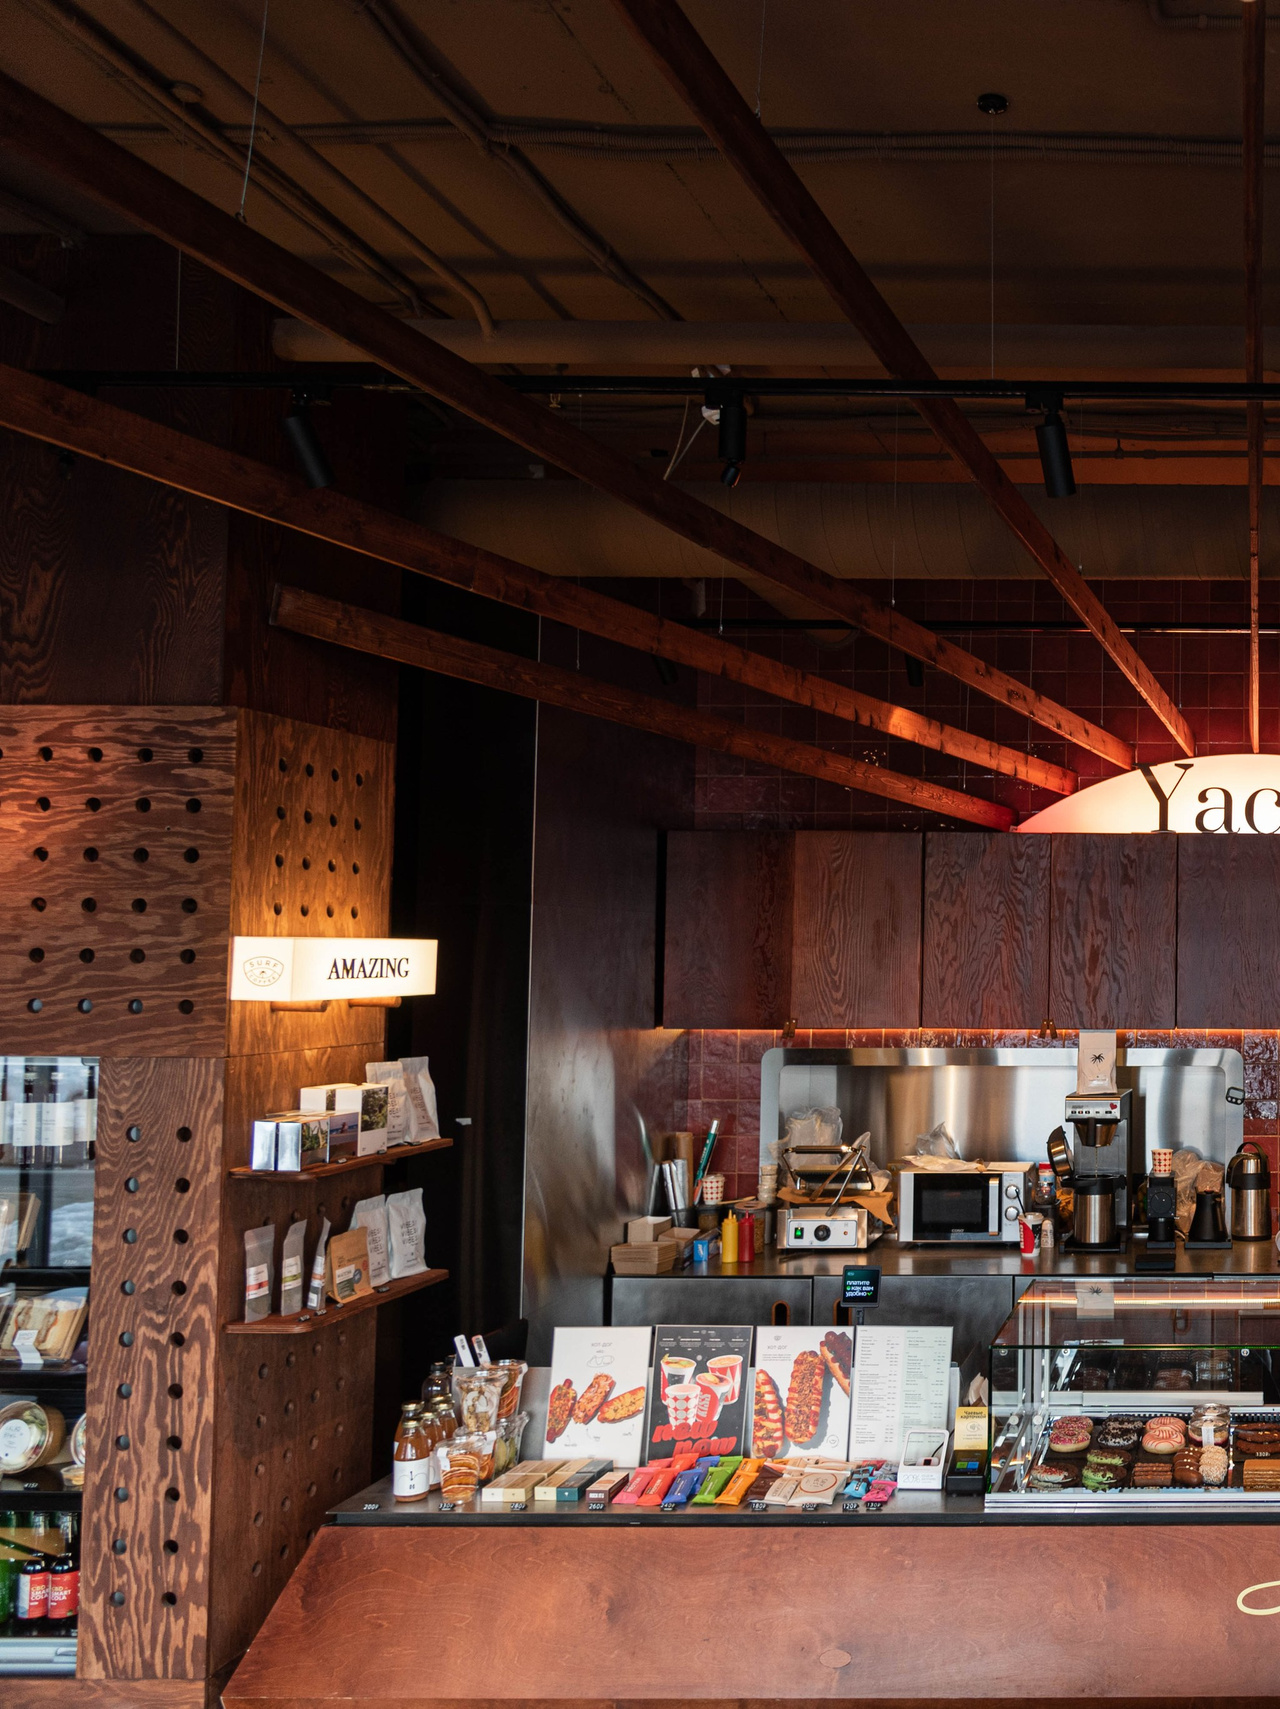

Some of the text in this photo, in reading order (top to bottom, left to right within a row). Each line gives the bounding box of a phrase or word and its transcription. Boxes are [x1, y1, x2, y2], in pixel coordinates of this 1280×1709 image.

[249, 960, 279, 968] SURF
[327, 958, 410, 980] AMAZING
[652, 1421, 718, 1443] new
